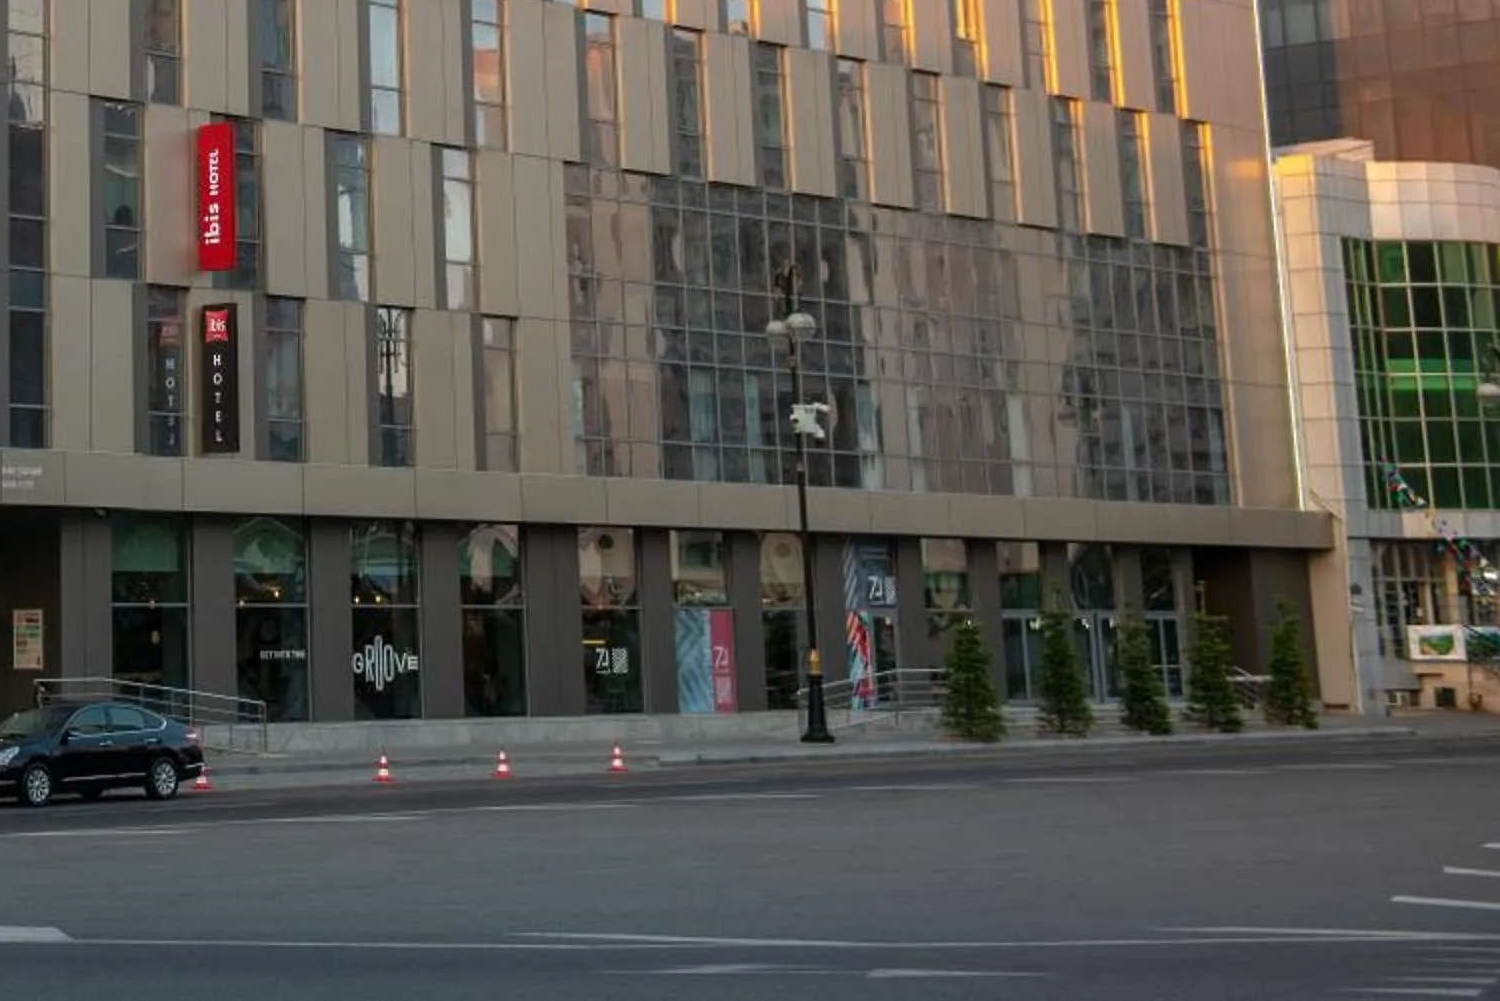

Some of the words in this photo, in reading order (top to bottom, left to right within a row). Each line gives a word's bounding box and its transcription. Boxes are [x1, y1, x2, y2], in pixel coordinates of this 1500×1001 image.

[209, 149, 219, 196] HOTEL
[204, 203, 221, 245] ibis
[213, 354, 223, 442] HOTEL
[353, 635, 419, 691] GROOVE
